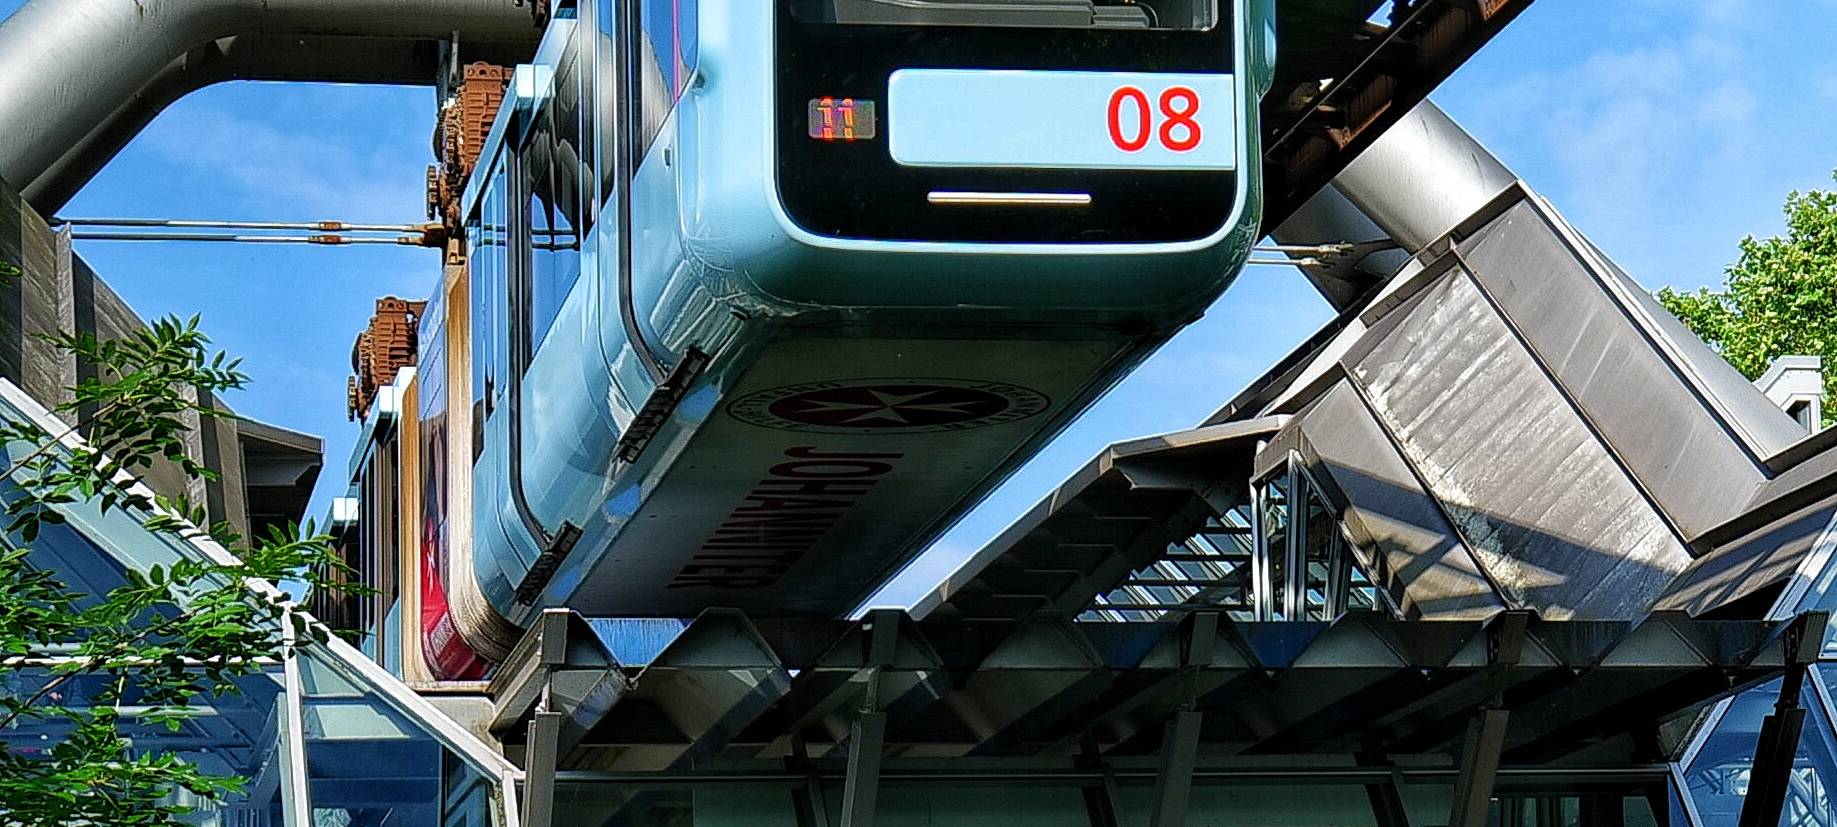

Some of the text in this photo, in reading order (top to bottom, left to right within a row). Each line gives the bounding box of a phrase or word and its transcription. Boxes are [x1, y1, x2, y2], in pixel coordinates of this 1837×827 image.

[817, 97, 856, 140] 11
[1107, 86, 1202, 152] 08
[667, 446, 905, 588] JOHANNITER
